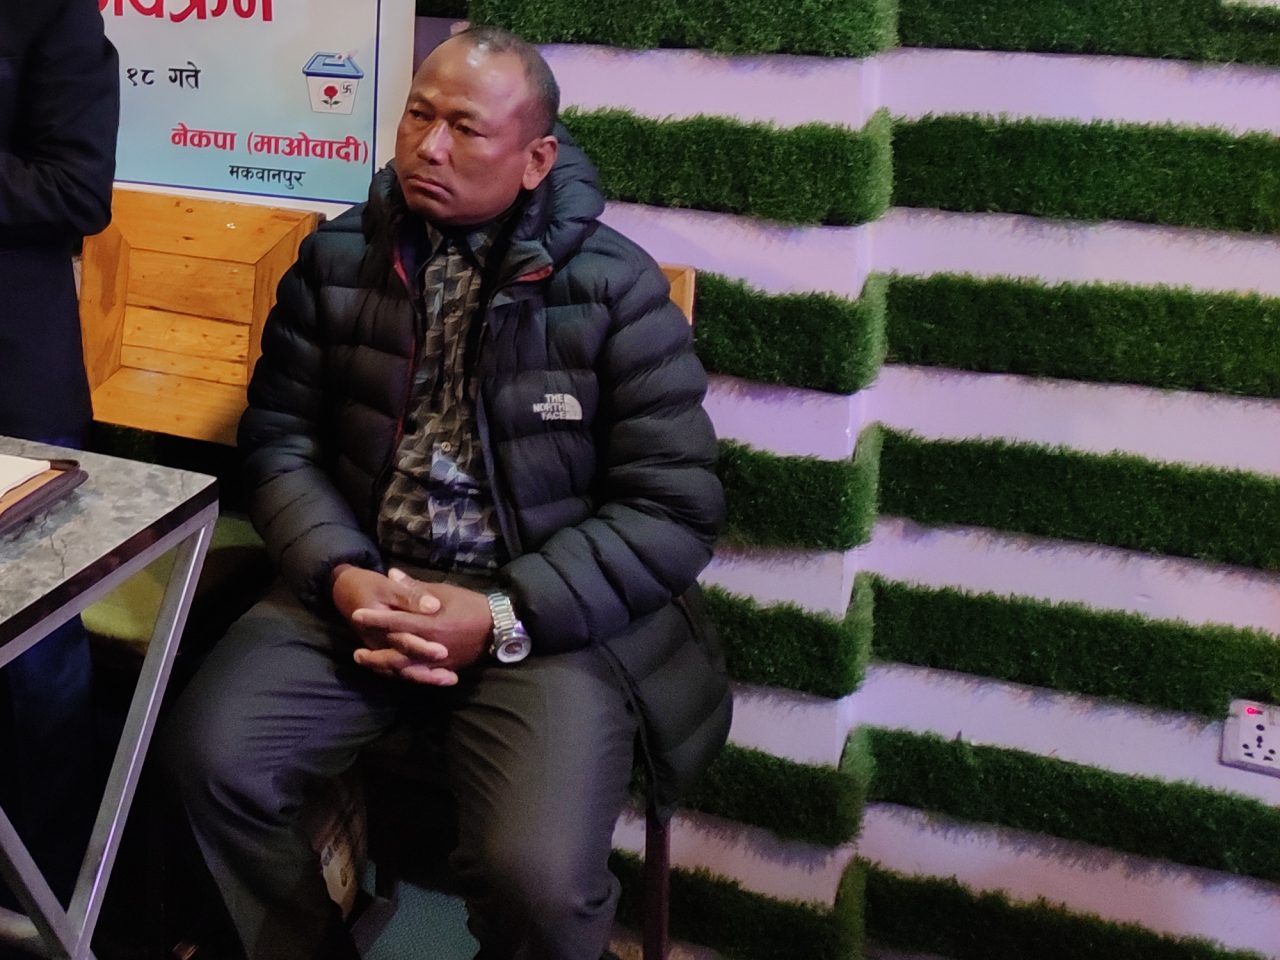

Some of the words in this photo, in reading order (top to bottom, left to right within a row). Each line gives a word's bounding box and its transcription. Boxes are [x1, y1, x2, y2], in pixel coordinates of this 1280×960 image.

[126, 67, 155, 86] १८
[168, 60, 201, 89] गते
[171, 122, 237, 151] नेकपा
[247, 131, 370, 165] (माओवादी)
[228, 164, 307, 190] मकवानपुर
[544, 393, 564, 403] THE
[532, 402, 565, 413] NORTH
[541, 411, 566, 420] FACE
